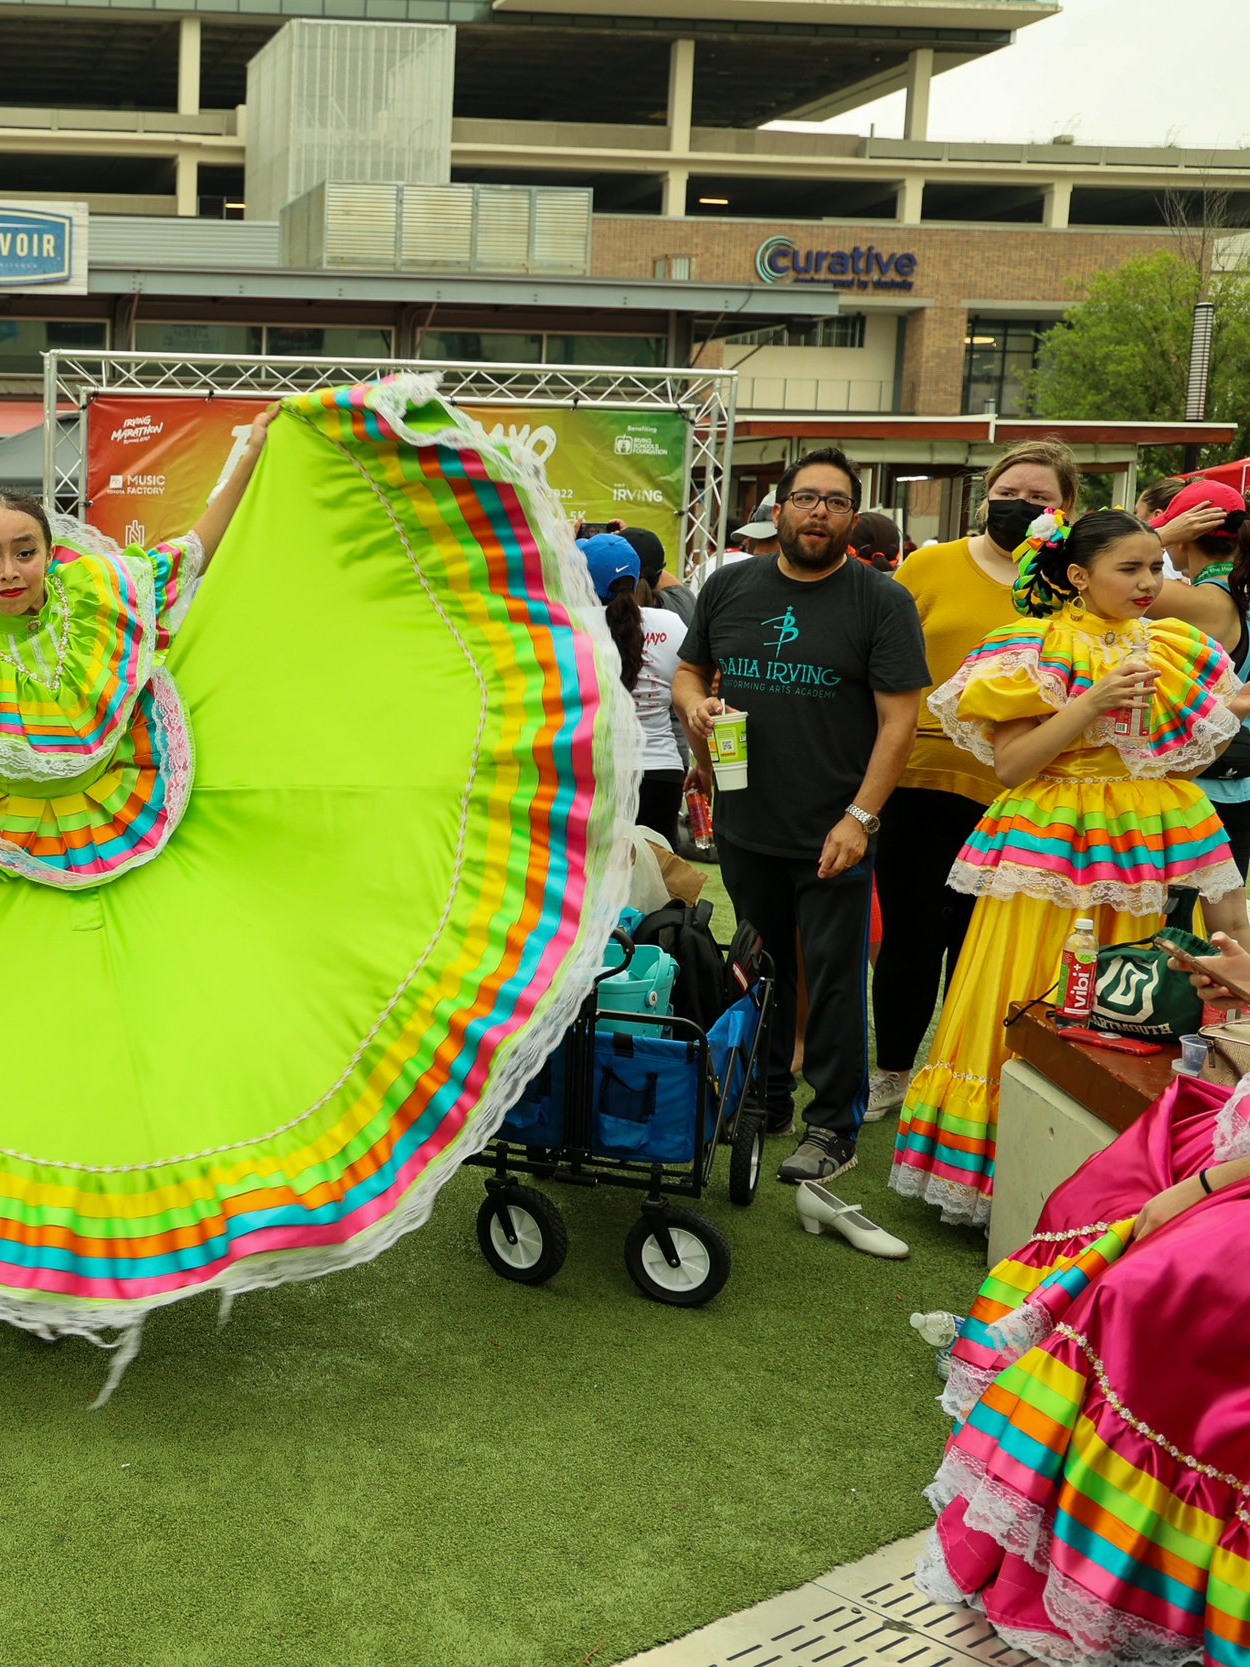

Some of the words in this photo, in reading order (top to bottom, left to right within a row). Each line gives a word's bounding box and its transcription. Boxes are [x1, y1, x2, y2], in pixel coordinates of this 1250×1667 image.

[111, 422, 164, 442] MARATHON
[627, 425, 658, 434] Benefiting
[126, 475, 166, 485] MUSIC
[127, 487, 165, 495] FACTORY
[613, 488, 663, 502] IRVING
[765, 661, 842, 686] IRVING
[769, 684, 791, 695] ARTS
[795, 687, 838, 700] ACADEMY
[1090, 1015, 1173, 1035] ARTMOUTH
